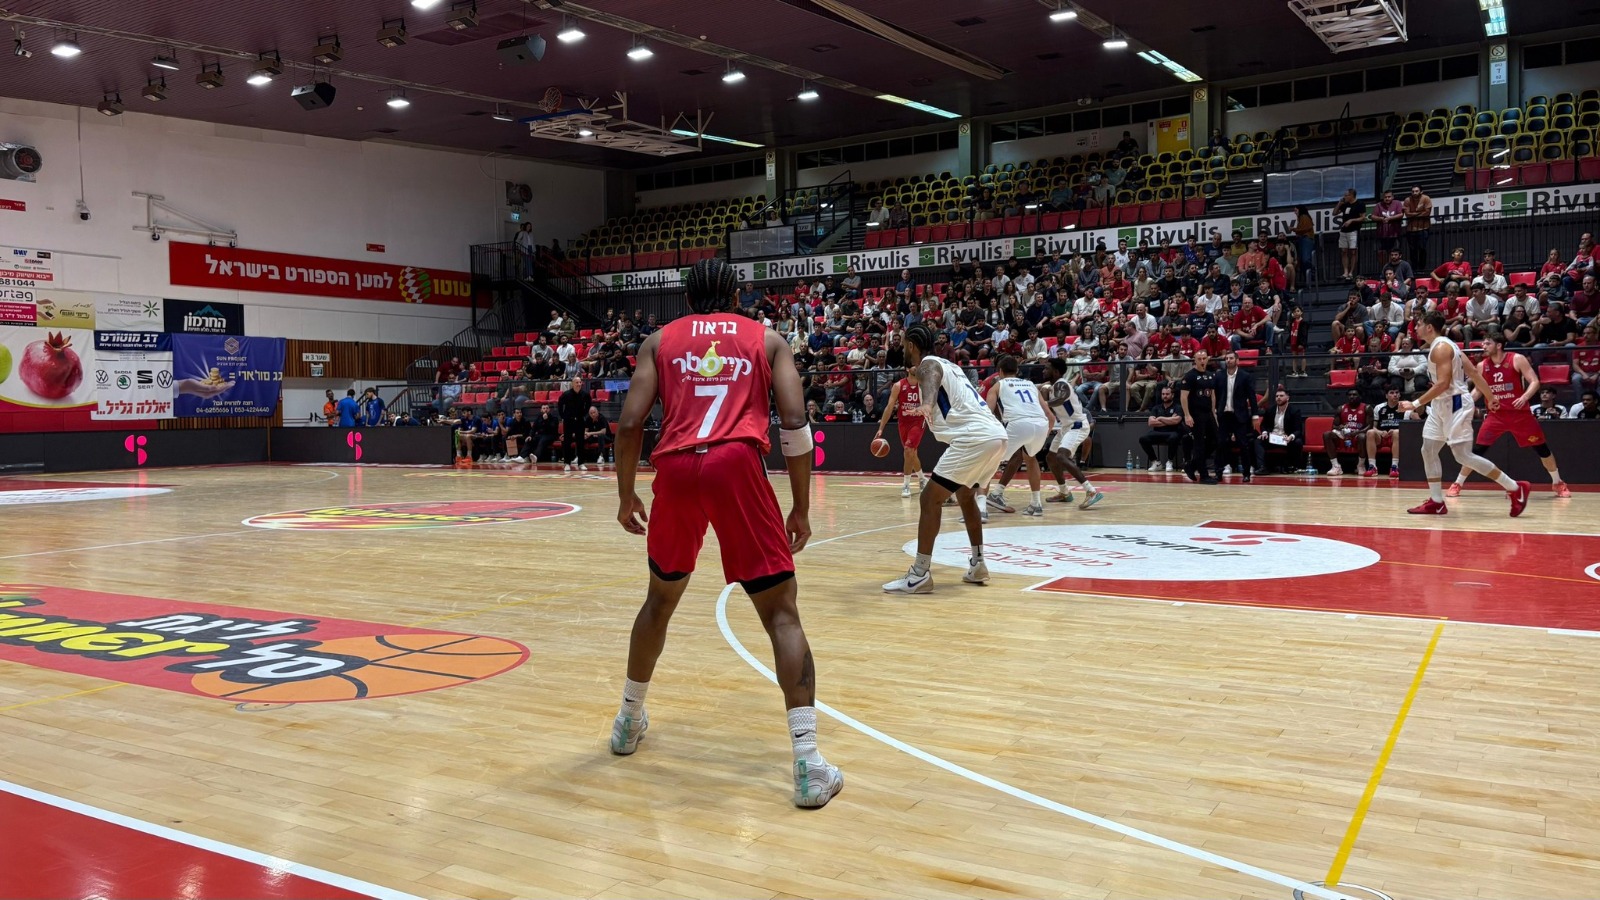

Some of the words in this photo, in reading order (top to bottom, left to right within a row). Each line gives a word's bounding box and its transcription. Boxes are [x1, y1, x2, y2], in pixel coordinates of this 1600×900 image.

[1140, 221, 1219, 244] Rivulis
[1257, 211, 1345, 238] Rivlis
[937, 241, 1002, 265] Rivulis
[1034, 232, 1106, 255] Rivulis
[205, 254, 281, 280] בישראל
[769, 258, 824, 279] Rivulis
[850, 250, 910, 272] Rivulis
[285, 266, 350, 286] הספורט
[355, 271, 394, 291] למען
[625, 271, 669, 288] Rivuli
[433, 278, 472, 297] טוטו
[183, 312, 227, 331] החרמון
[692, 320, 738, 337] בראון
[100, 332, 141, 343] מוטורס
[142, 333, 159, 343] דב
[238, 369, 270, 382] סולארי
[273, 371, 283, 382] גג
[1492, 371, 1504, 383] 12
[907, 392, 919, 402] 50
[1015, 389, 1034, 403] 11
[136, 399, 171, 415] יאללה
[694, 384, 729, 439] 7
[1347, 413, 1358, 421] 64
[1092, 534, 1253, 558] shamir
[194, 642, 347, 679] סל
